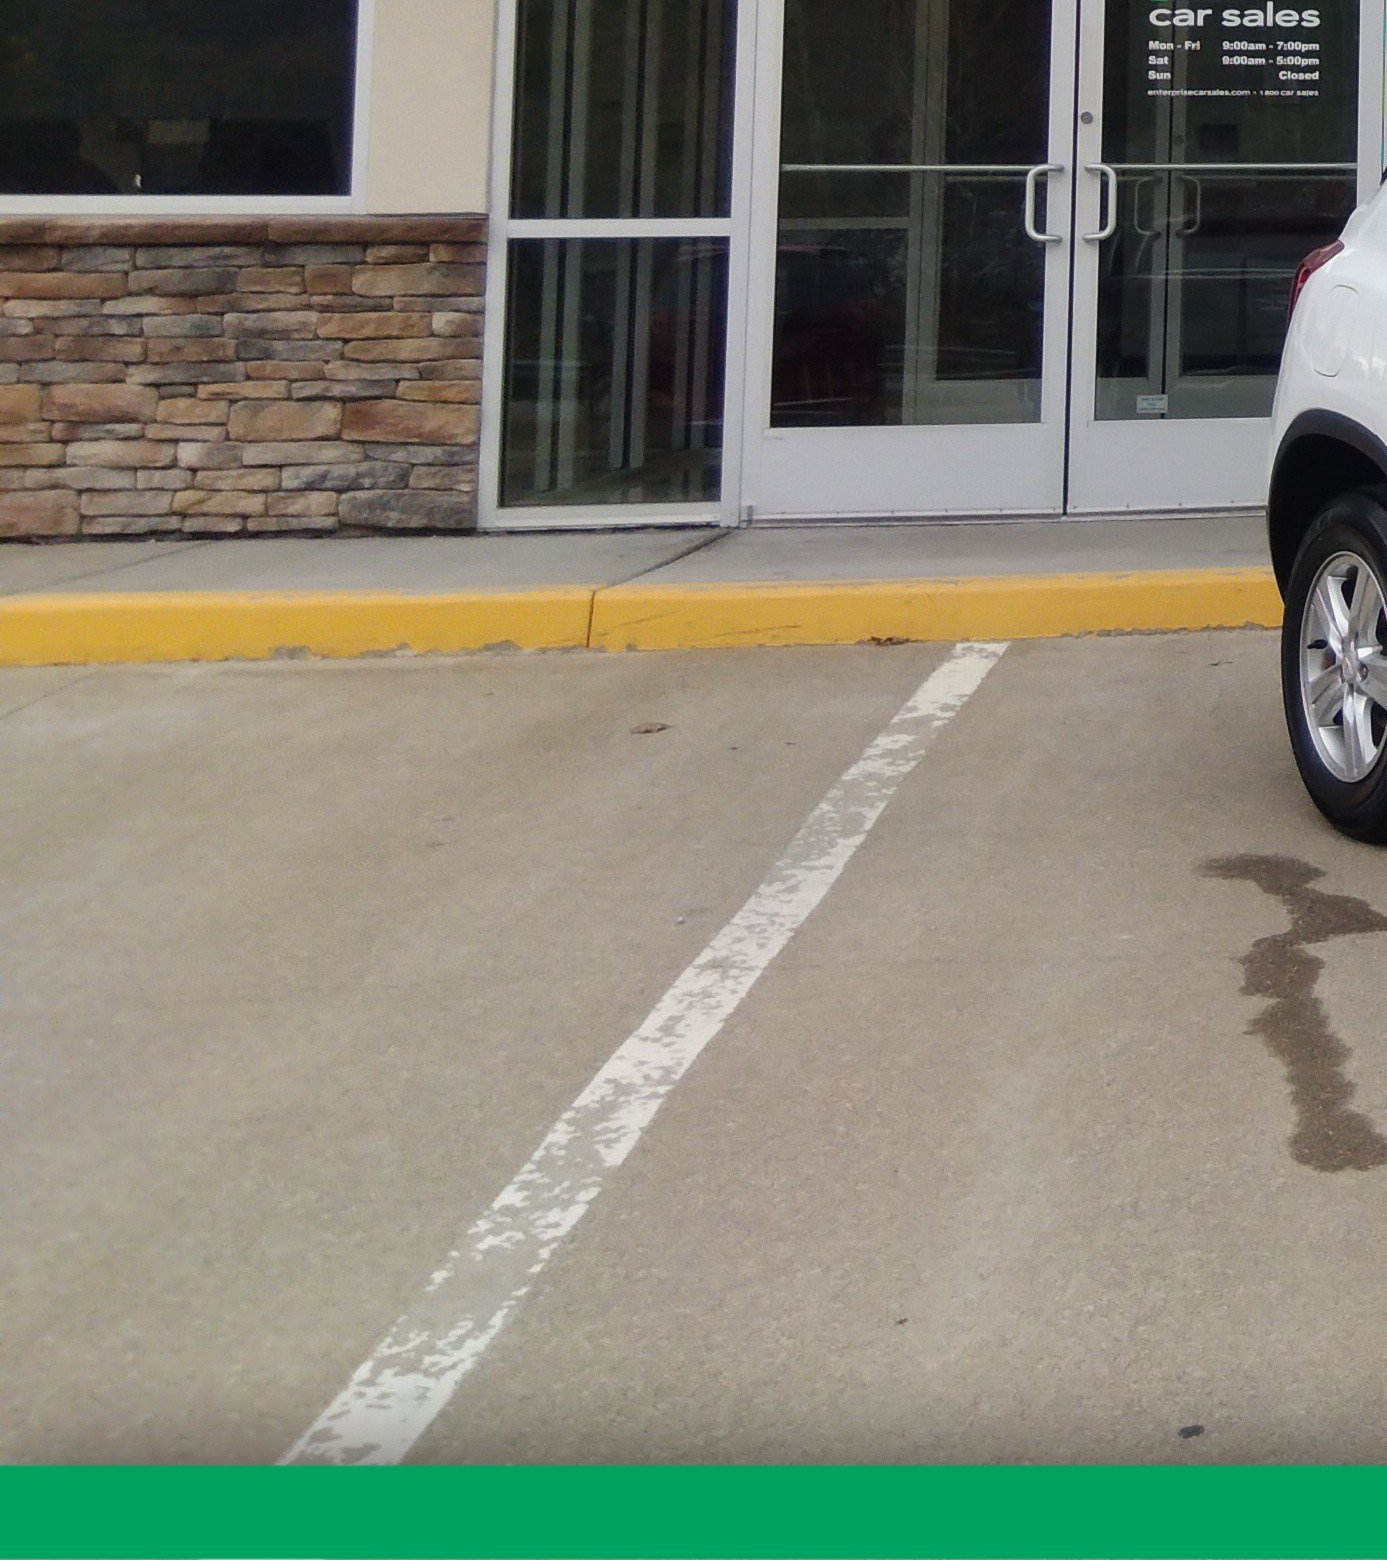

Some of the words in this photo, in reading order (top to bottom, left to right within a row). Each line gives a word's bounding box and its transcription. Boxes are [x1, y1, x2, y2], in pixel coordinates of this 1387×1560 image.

[1149, 8, 1213, 27] car
[1221, 1, 1321, 28] sales
[1148, 41, 1174, 51] Mon
[1184, 40, 1201, 51] Fri
[1222, 41, 1267, 51] 9:00am
[1276, 41, 1320, 53] 7:00pm
[1148, 55, 1169, 65] Sat
[1147, 70, 1172, 80] Sun
[1278, 70, 1320, 80] Closed
